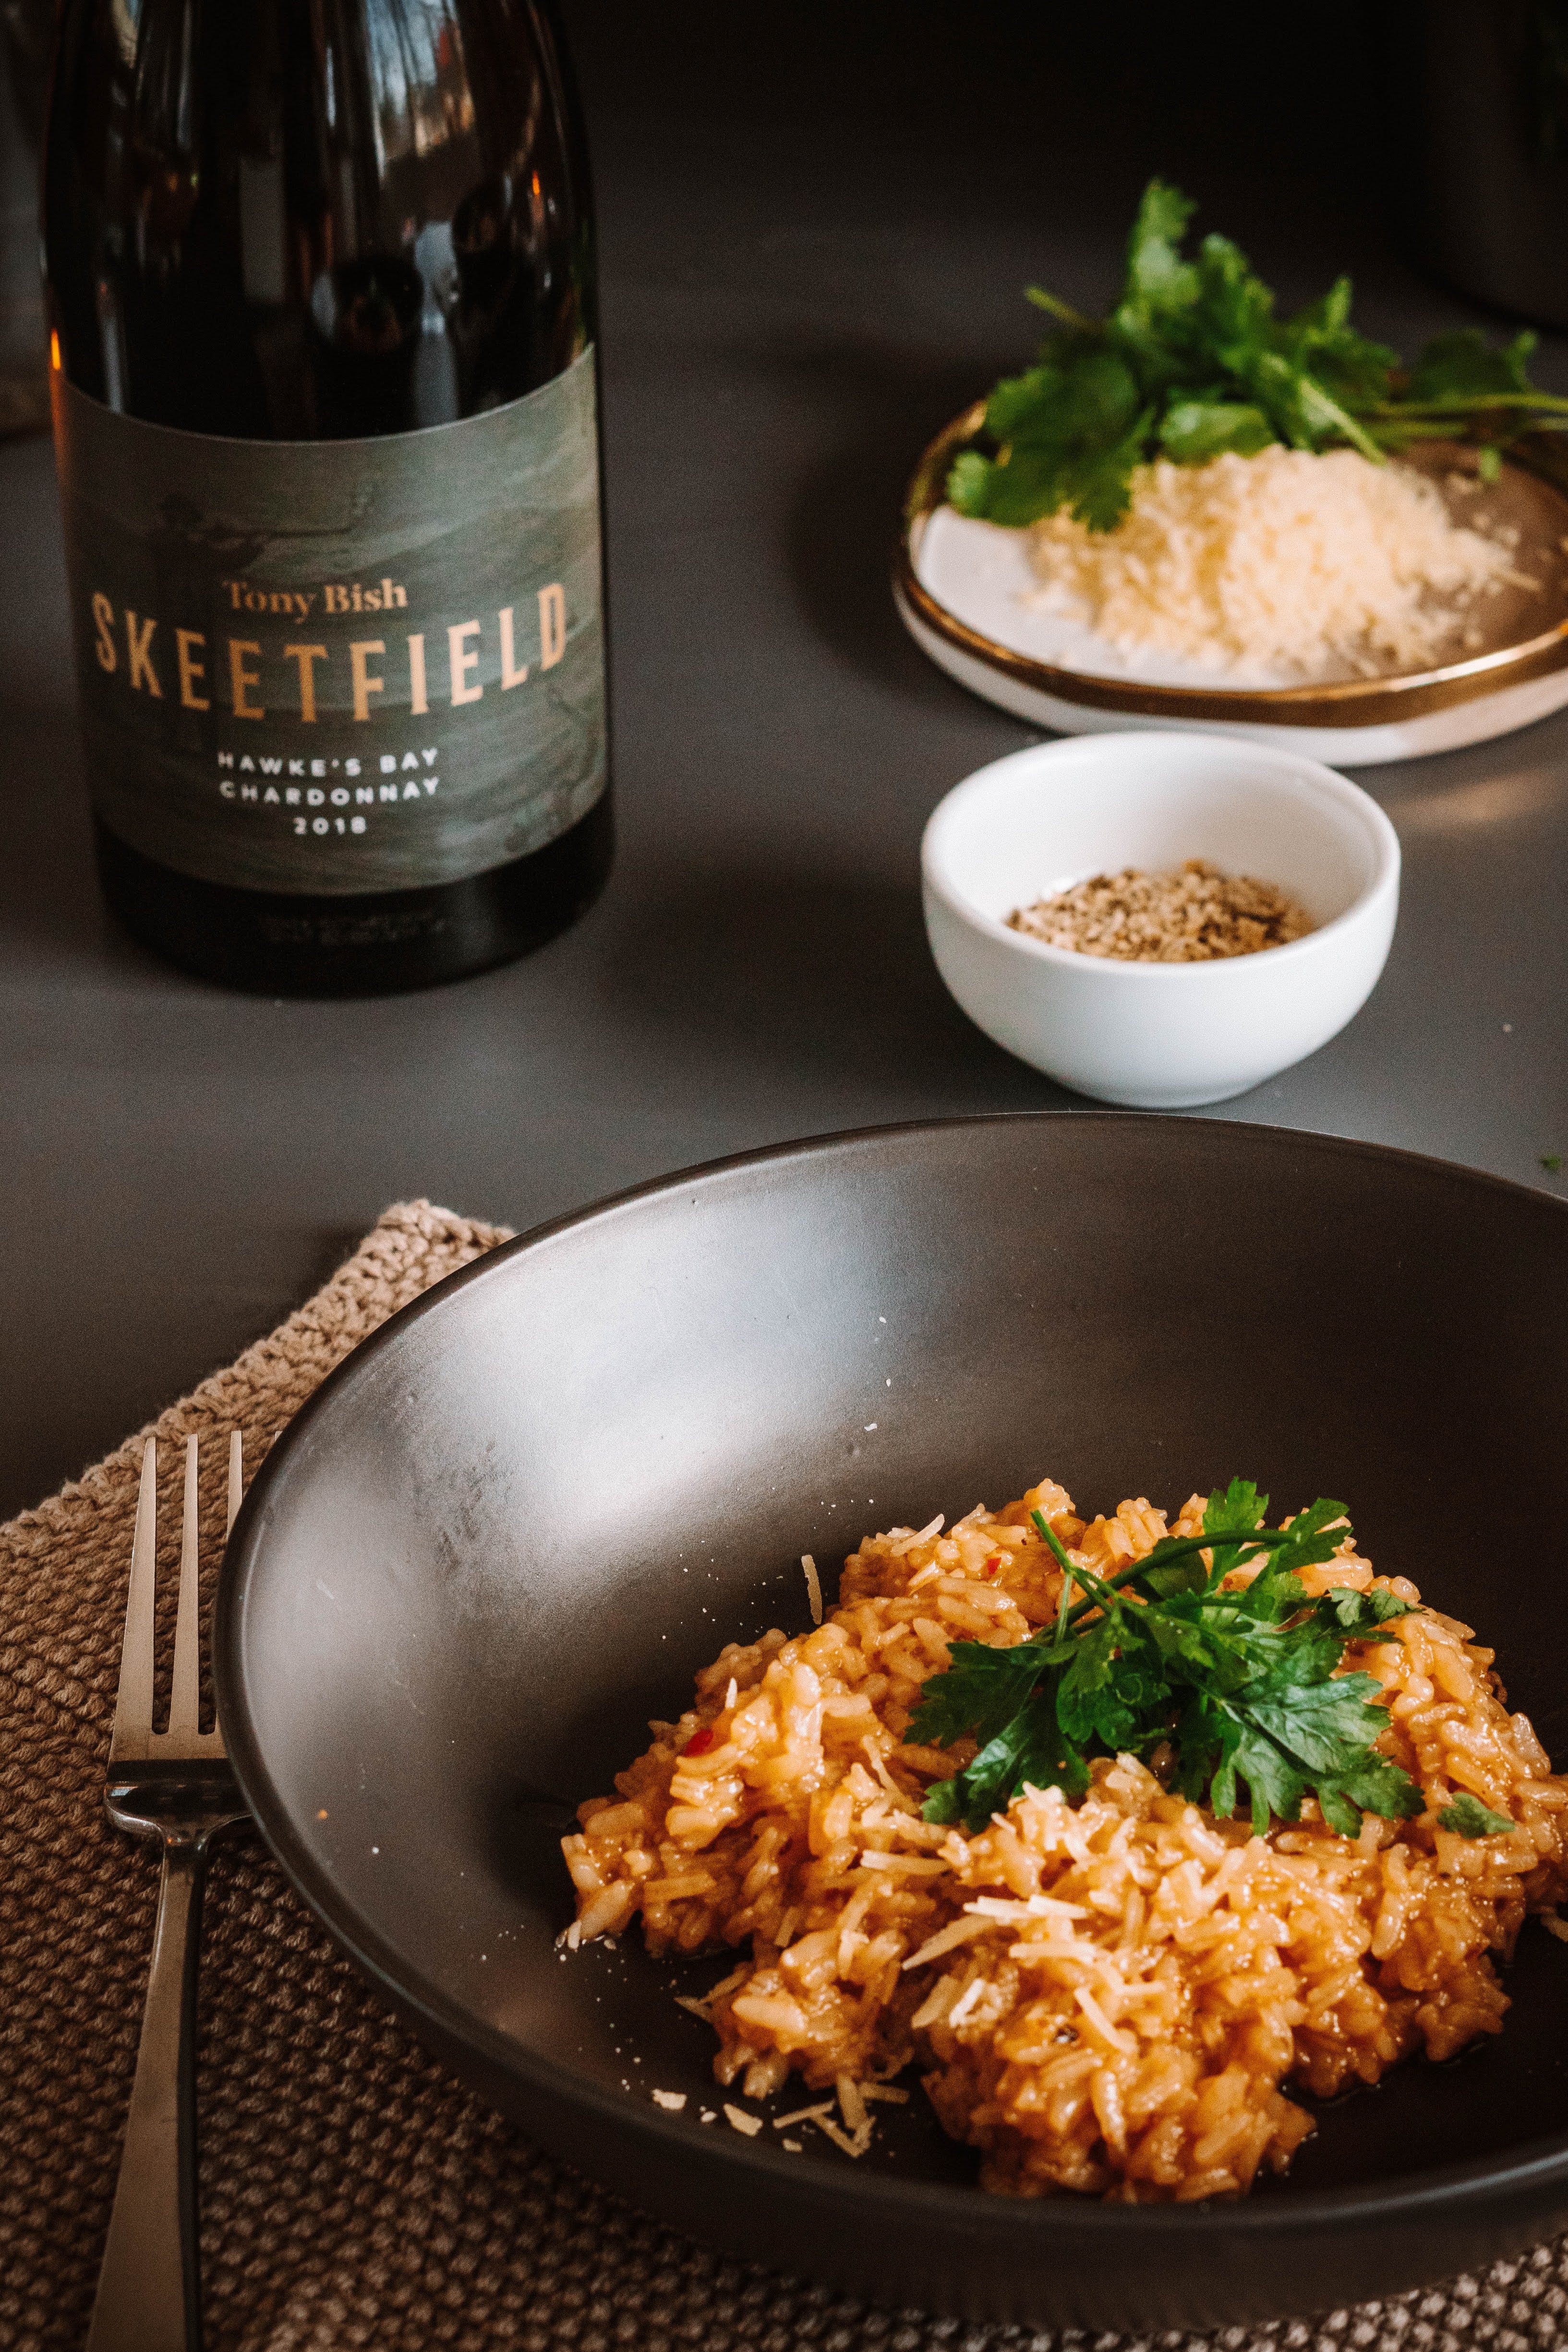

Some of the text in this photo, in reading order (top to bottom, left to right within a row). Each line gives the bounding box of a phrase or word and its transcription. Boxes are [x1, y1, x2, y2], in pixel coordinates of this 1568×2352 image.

[221, 578, 408, 624] Tony Bish
[92, 582, 567, 722] SKEETFIELD
[217, 747, 438, 777] HAWKE'S BAY
[219, 776, 439, 806] CHARDONNAY
[292, 816, 367, 835] 2018
